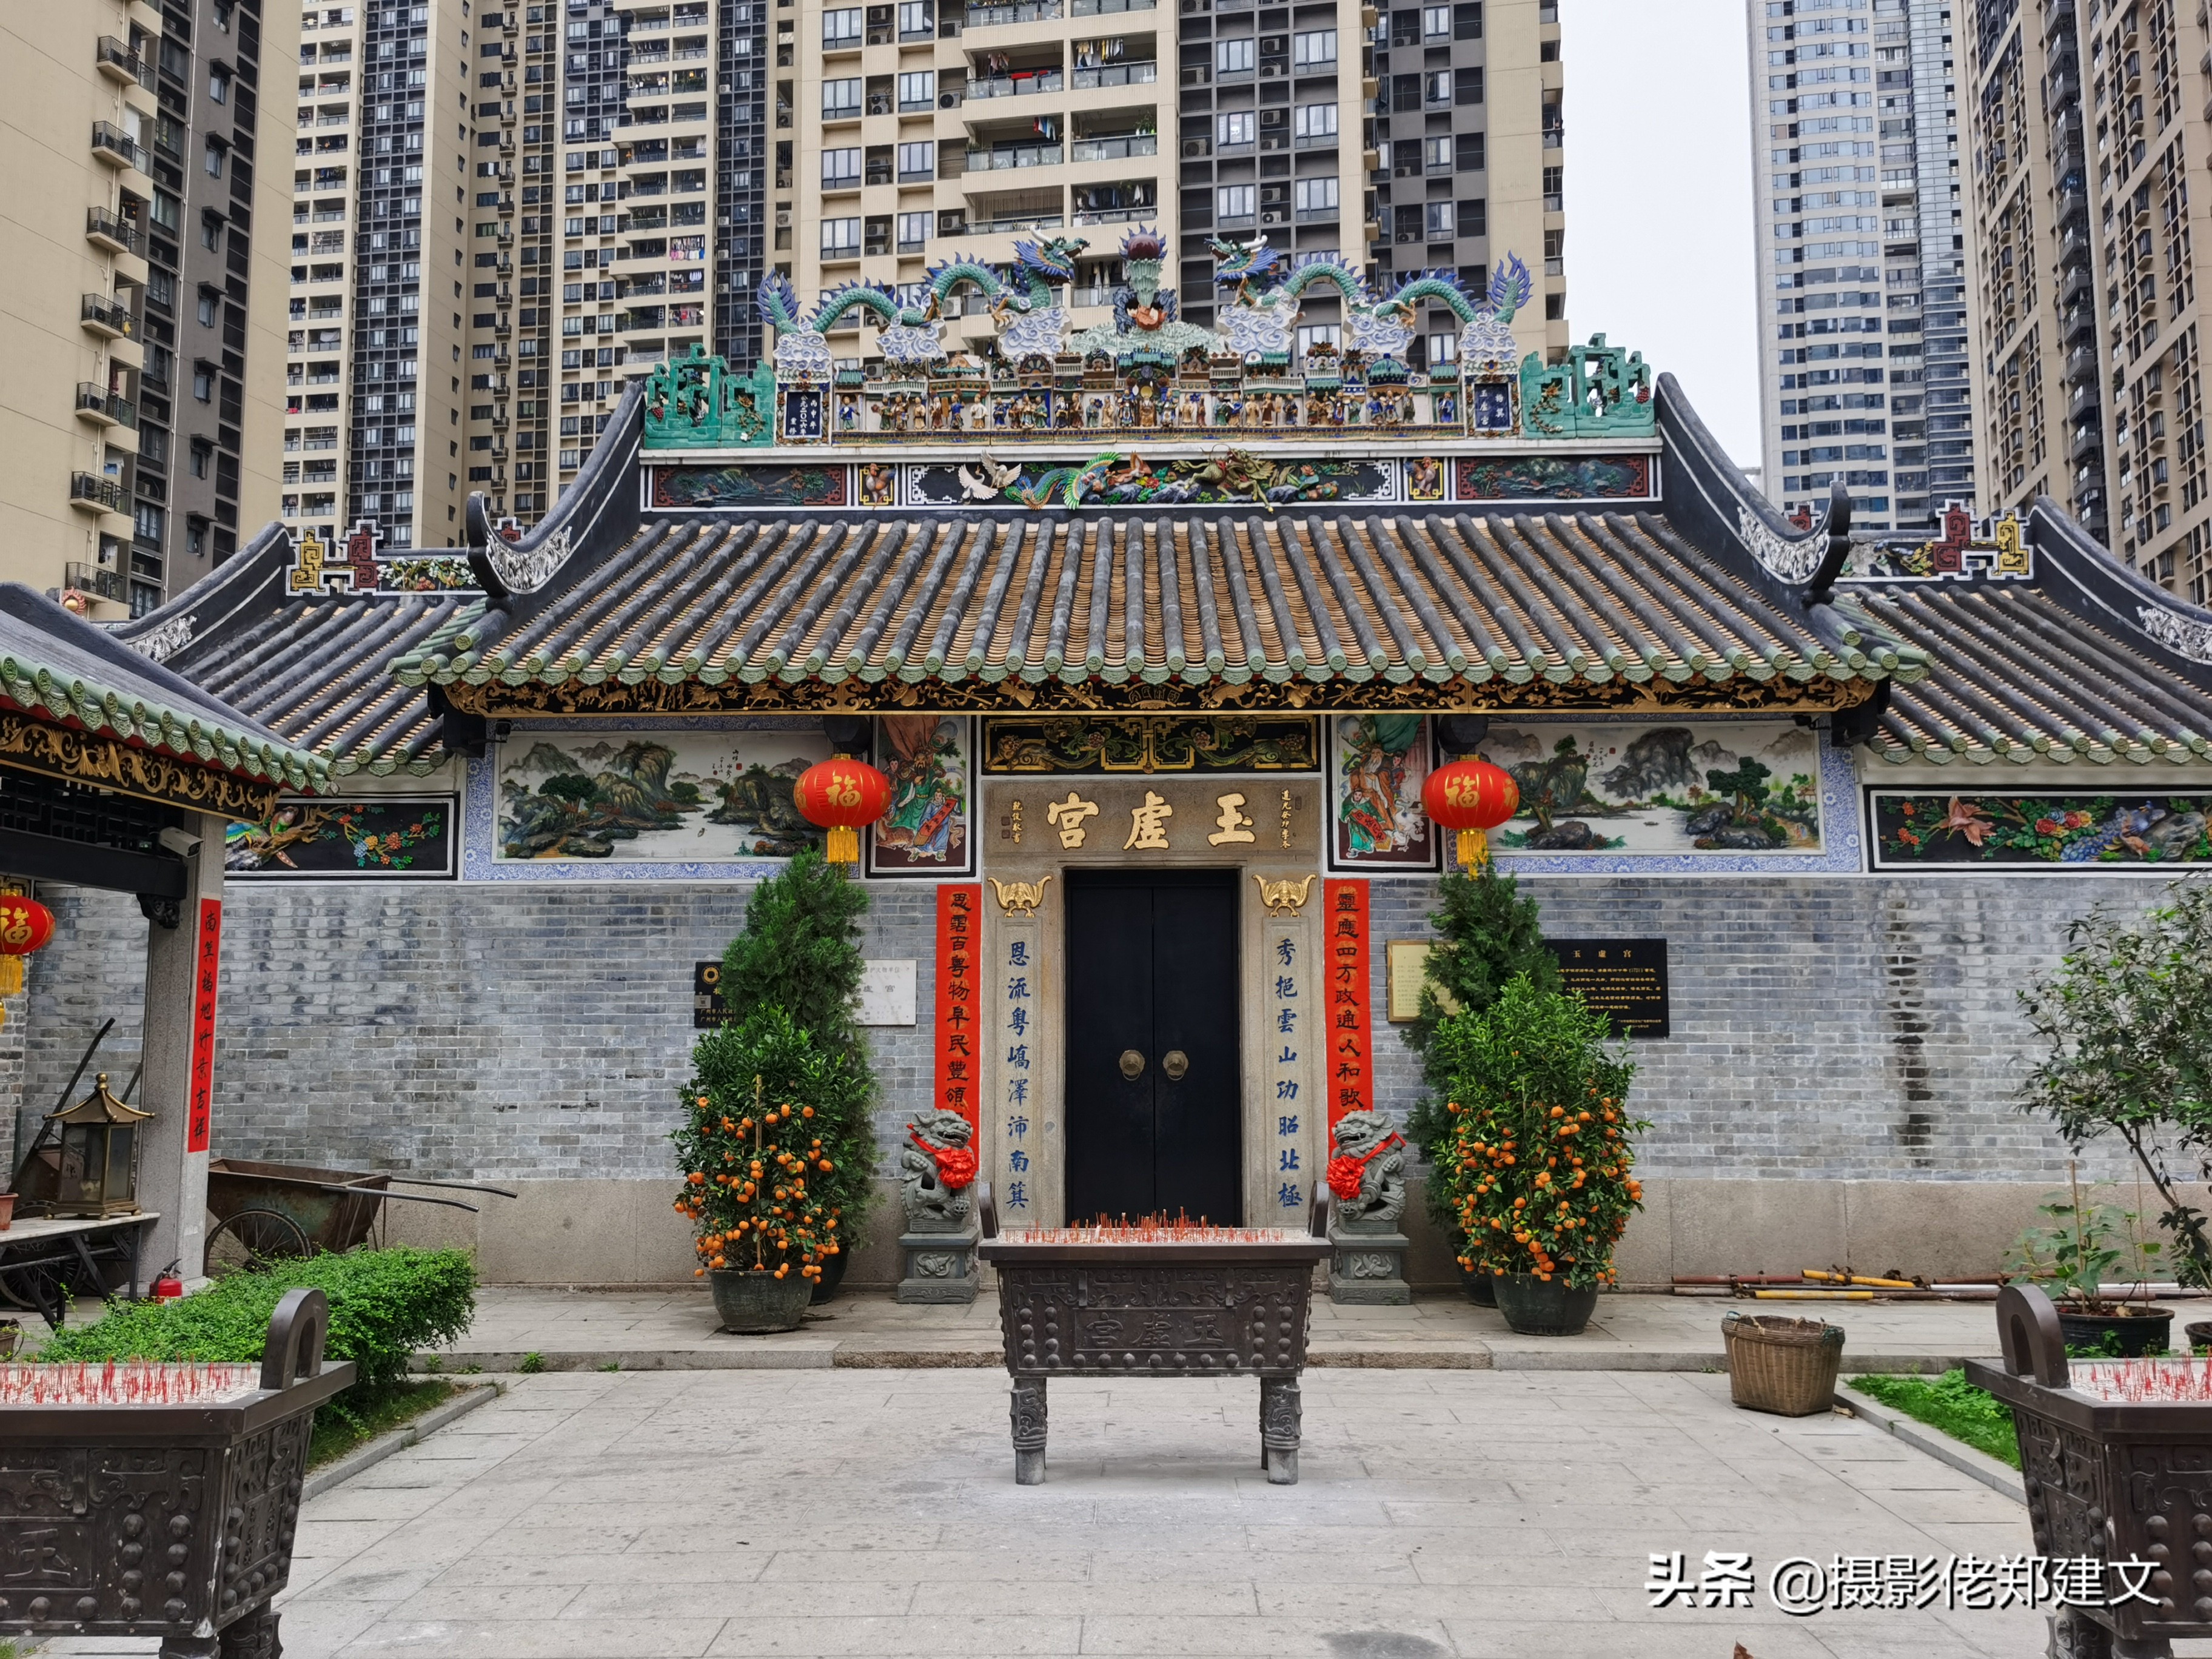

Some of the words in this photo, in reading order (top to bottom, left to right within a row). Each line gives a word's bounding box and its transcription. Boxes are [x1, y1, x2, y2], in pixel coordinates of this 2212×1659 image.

[825, 775, 861, 807] 福
[1445, 776, 1480, 808] 福
[1335, 893, 1364, 1116] 靈應四方政通人和歌
